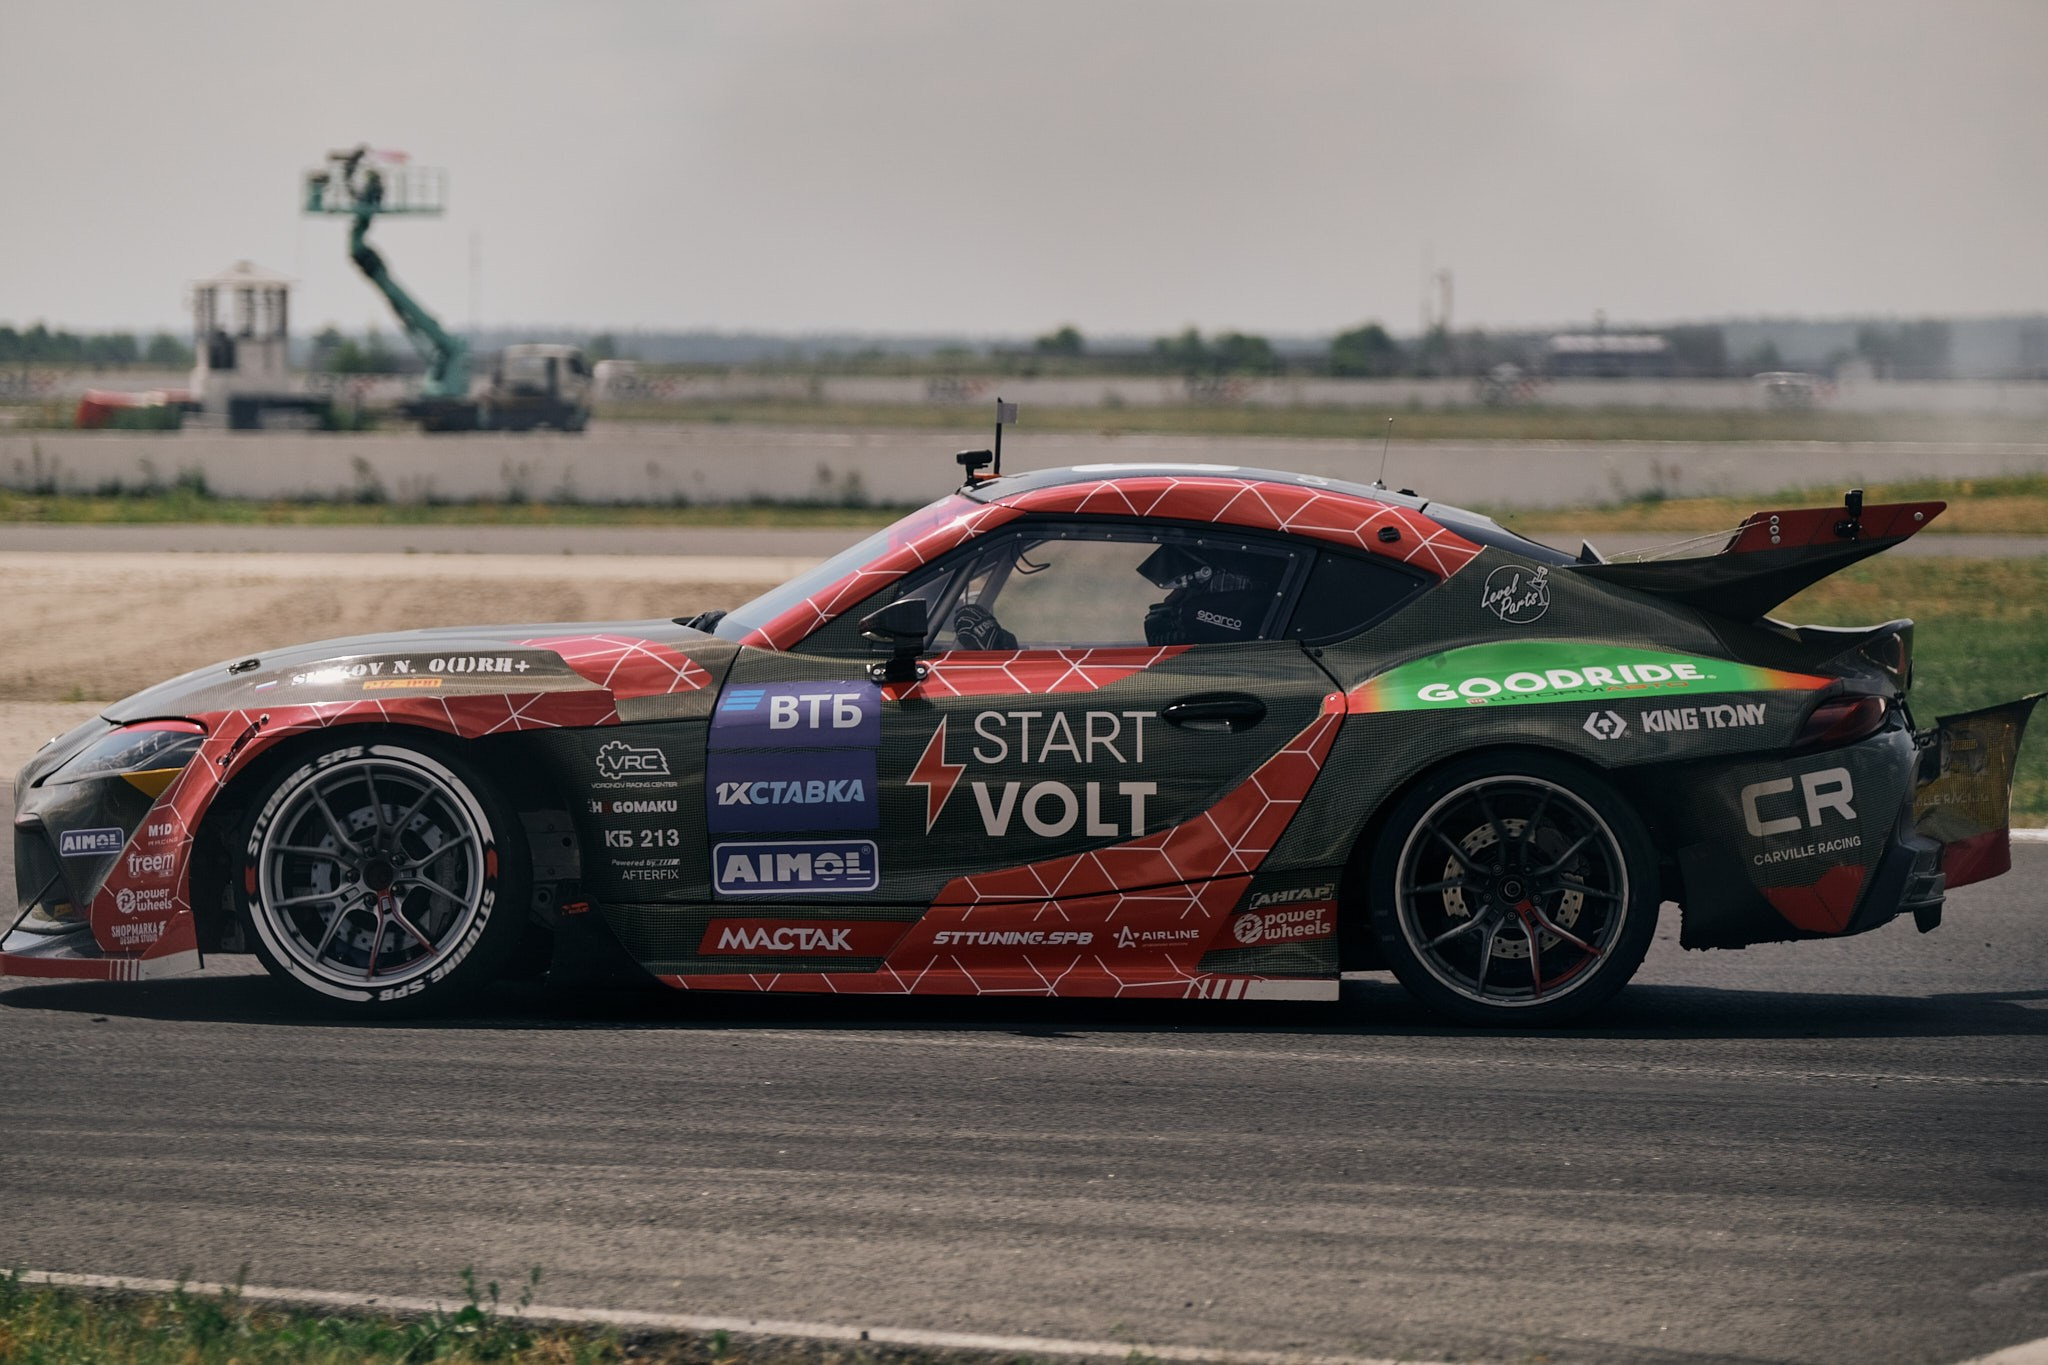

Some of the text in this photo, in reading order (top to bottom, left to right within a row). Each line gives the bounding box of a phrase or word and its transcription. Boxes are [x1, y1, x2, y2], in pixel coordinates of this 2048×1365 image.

[1481, 572, 1519, 608] Level
[1500, 592, 1538, 620] Parts
[1417, 663, 1705, 702] GOODRIDE
[769, 692, 863, 730] ВТБ
[1640, 703, 1767, 733] KING TONY
[972, 710, 1158, 764] START
[607, 755, 658, 770] VRC
[971, 780, 1158, 837] VOLT
[1741, 767, 1857, 837] CR
[62, 833, 121, 851] AIMOL
[640, 828, 680, 848] 213
[1753, 835, 1862, 866] CARVILLE RACING
[128, 853, 175, 874] freem
[611, 859, 645, 867] Powered
[720, 852, 871, 883] AIMOL
[622, 869, 680, 880] AFTERFIX
[136, 888, 170, 902] power
[136, 897, 173, 911] wheels
[1264, 908, 1326, 929] power
[111, 922, 158, 938] SHOPMARKA
[933, 931, 1095, 946] STTUNING.SPB
[1141, 929, 1200, 941] AIRLINE
[1264, 920, 1332, 940] wheels
